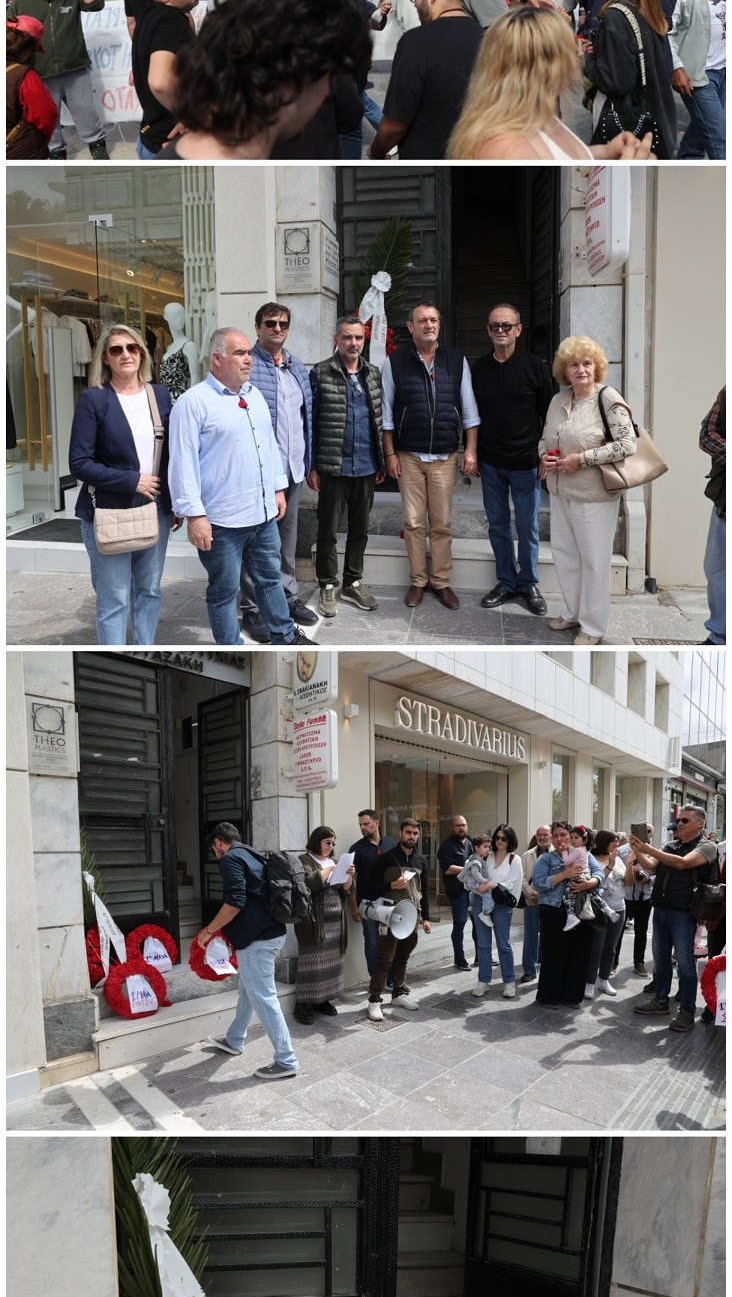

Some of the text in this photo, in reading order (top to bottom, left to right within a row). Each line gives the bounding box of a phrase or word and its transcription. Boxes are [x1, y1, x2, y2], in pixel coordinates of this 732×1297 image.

[284, 257, 310, 266] THEO
[306, 714, 326, 725] Femme
[397, 696, 526, 761] STRADIVARIUS
[34, 734, 66, 747] THEO
[34, 744, 66, 753] PLASTICS
